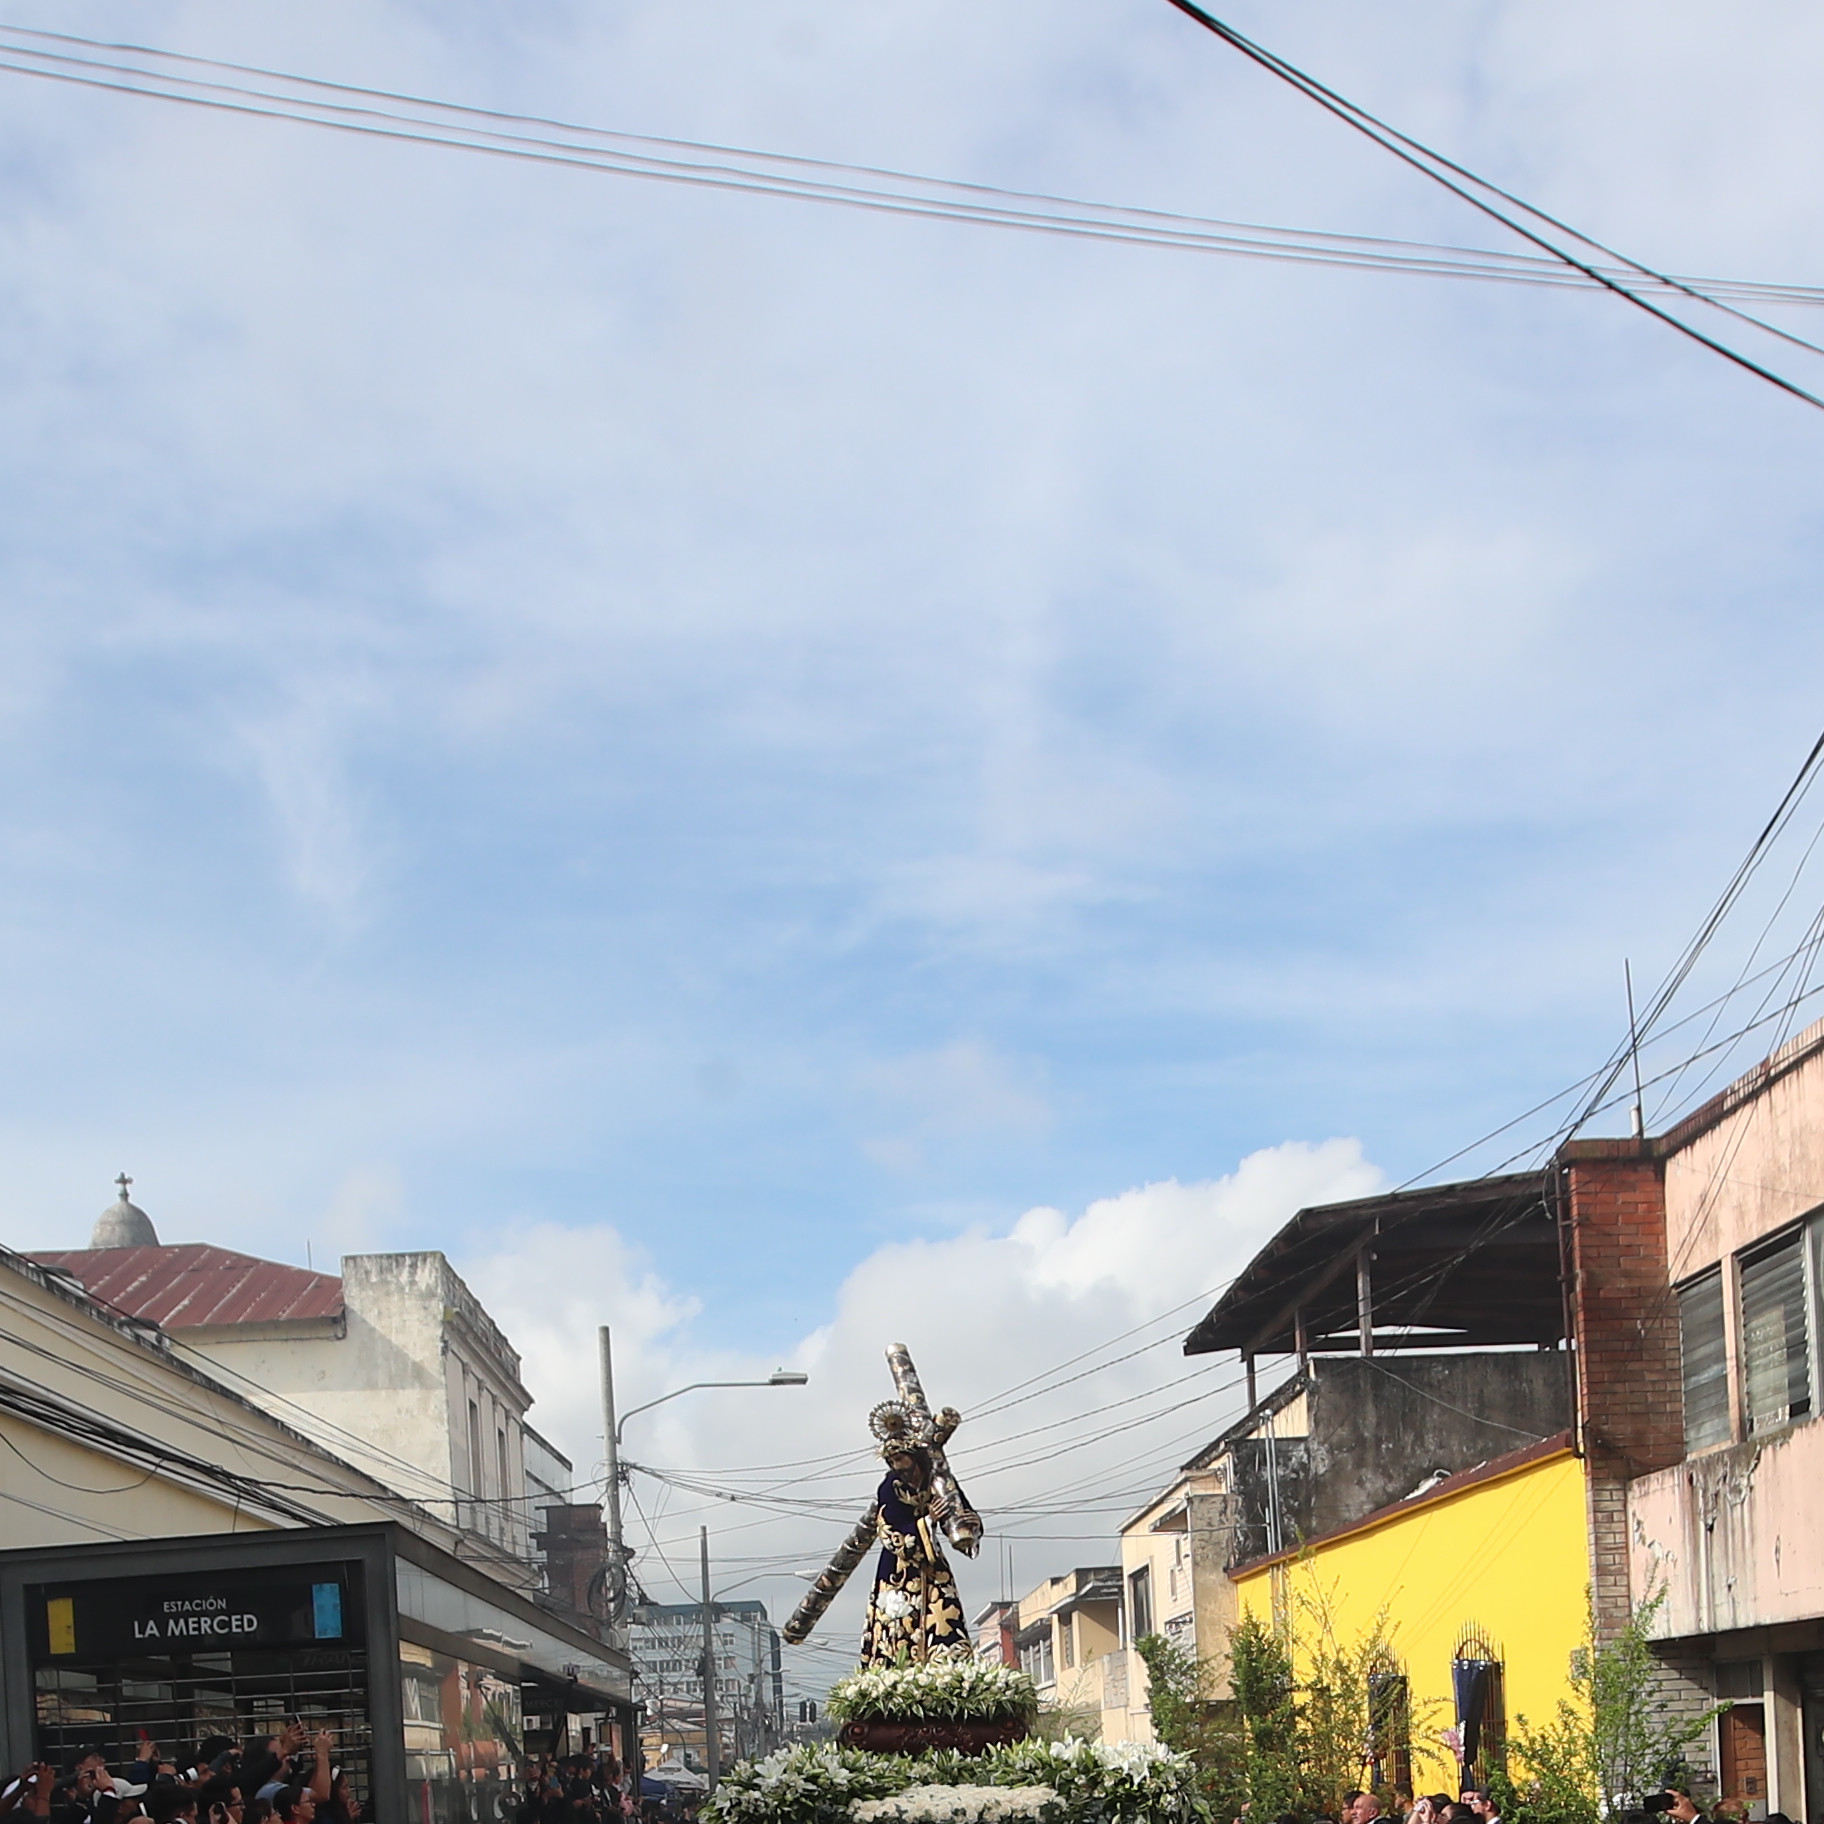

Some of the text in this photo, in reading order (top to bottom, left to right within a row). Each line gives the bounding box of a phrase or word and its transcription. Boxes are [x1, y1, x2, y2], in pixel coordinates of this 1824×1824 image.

[163, 1596, 227, 1613] ESTACIÓN
[133, 1613, 258, 1639] LA MERCED
